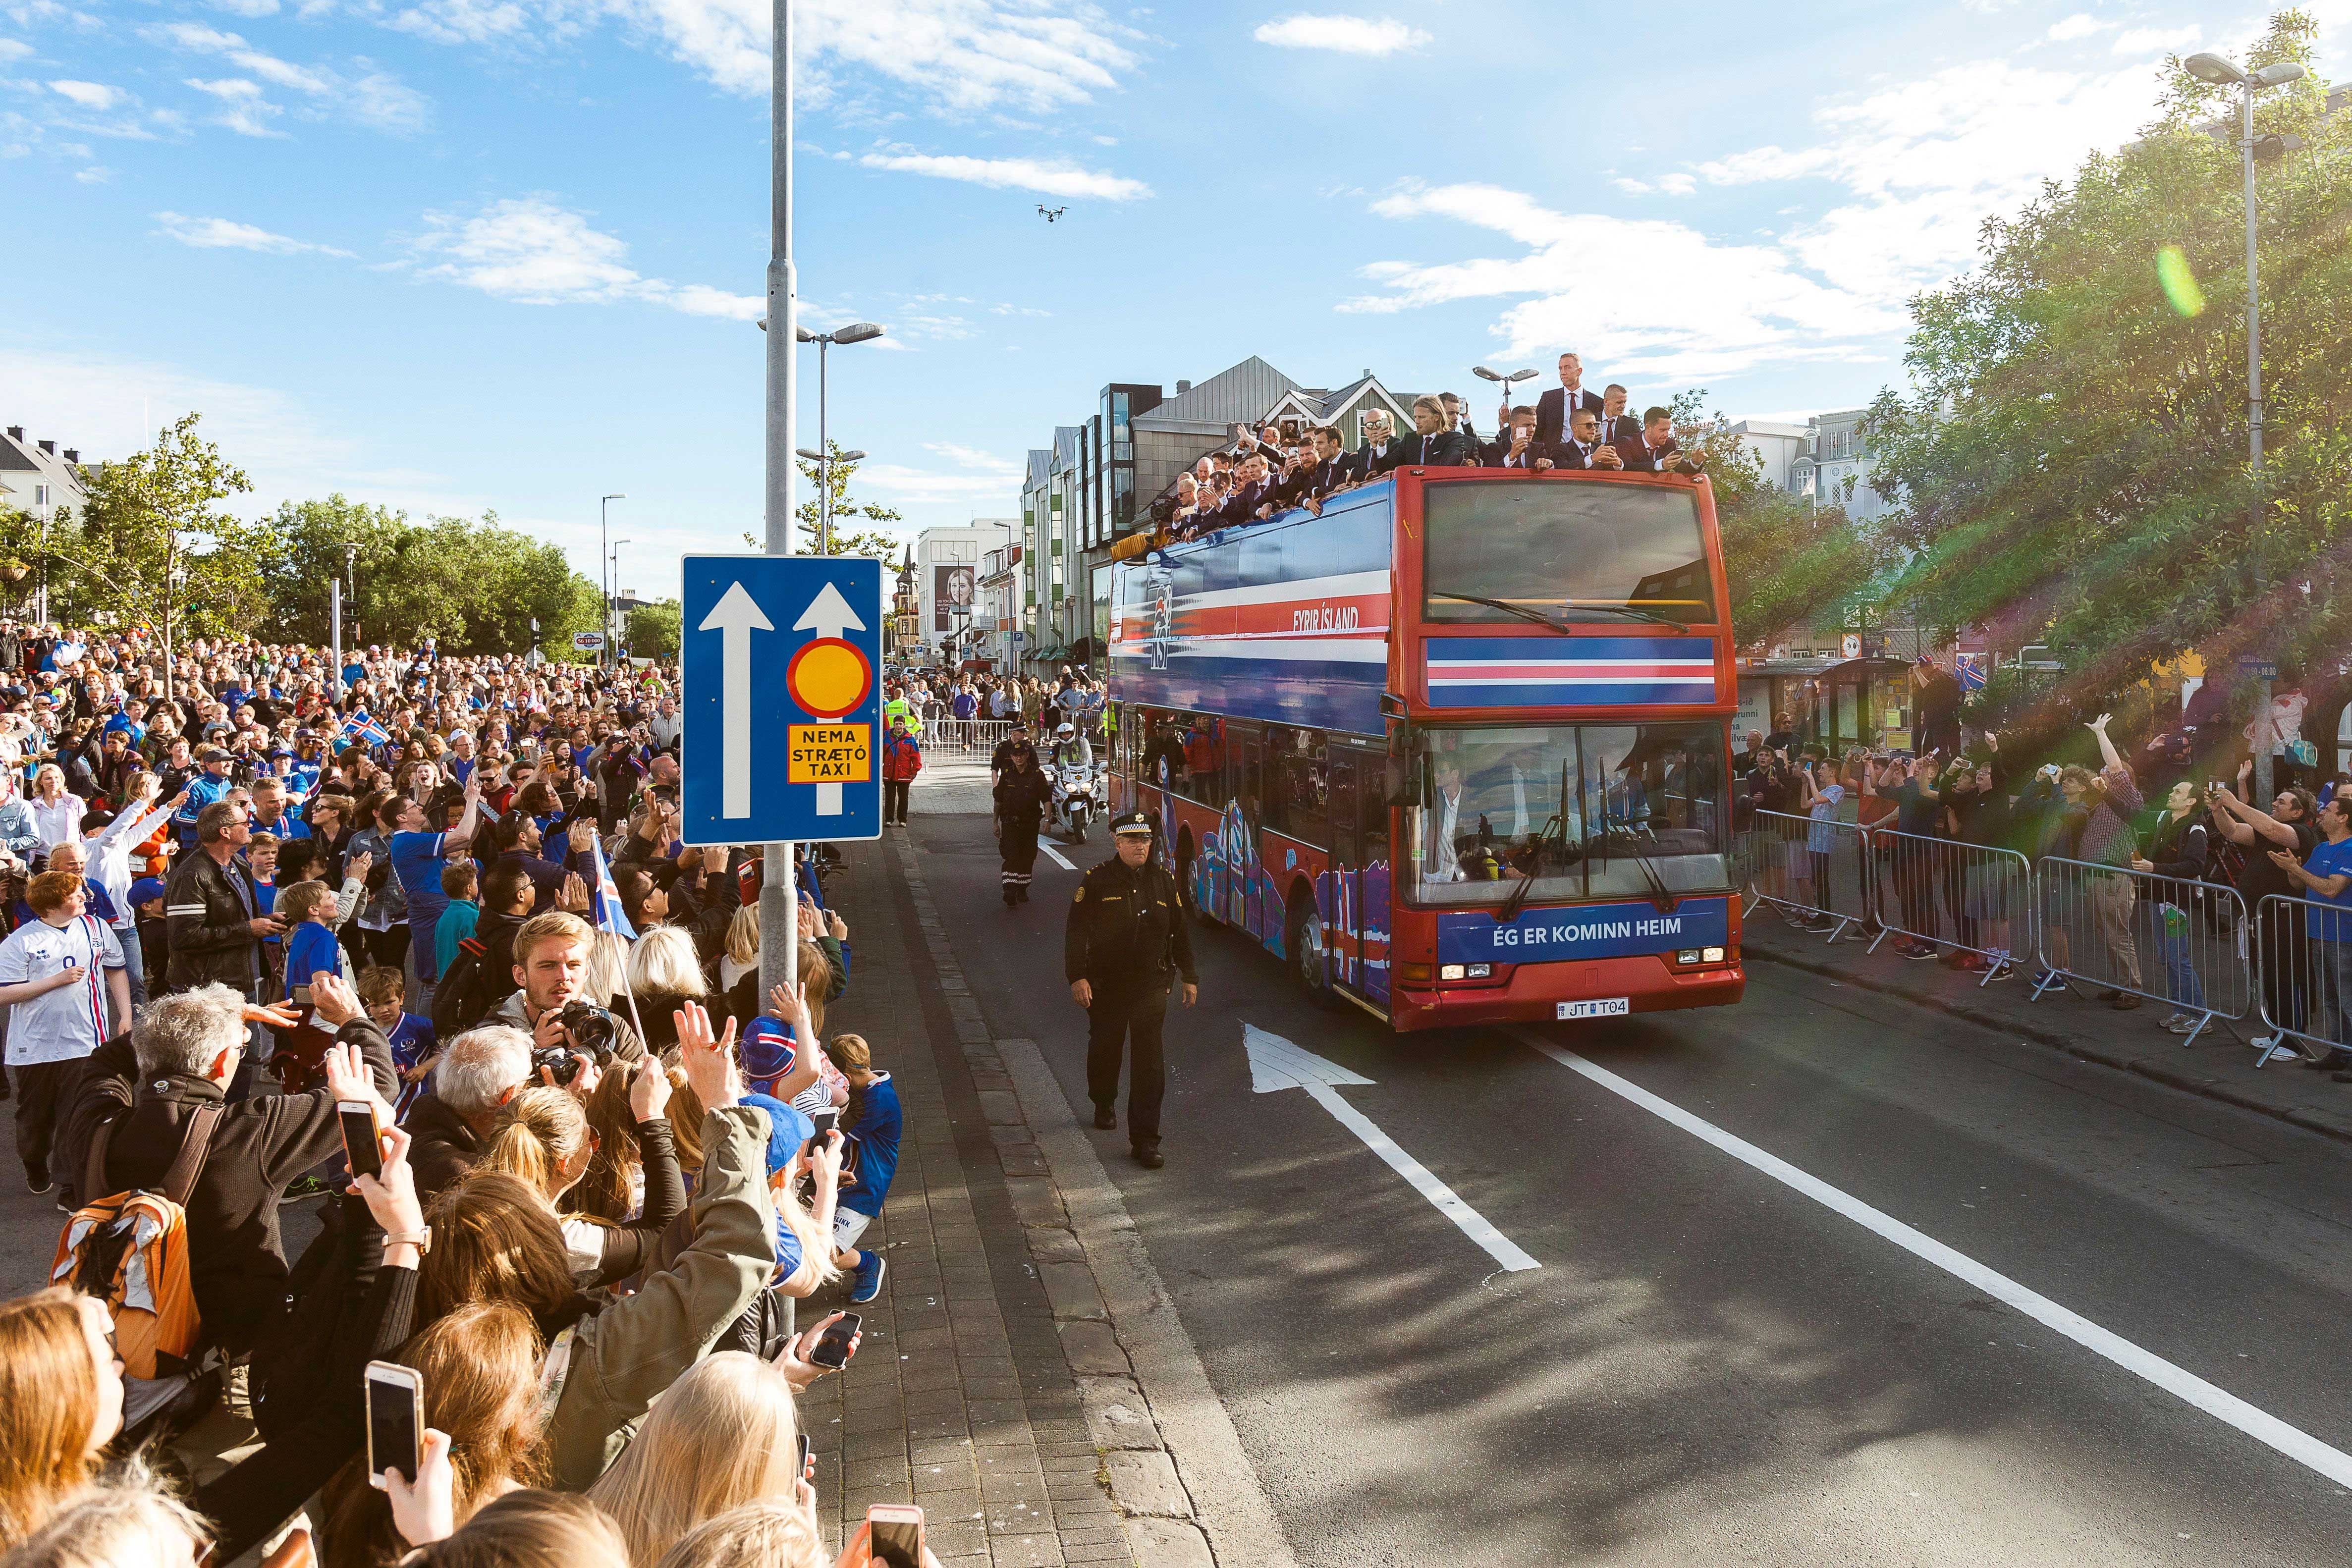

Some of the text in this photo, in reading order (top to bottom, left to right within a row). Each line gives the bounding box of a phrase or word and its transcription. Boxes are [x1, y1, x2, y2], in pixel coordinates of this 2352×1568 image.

[1293, 601, 1359, 632] FYRIR ÍSLAND
[803, 730, 856, 743] NEMA
[792, 745, 866, 761] STRÆTÓ
[809, 763, 850, 776] TAXI
[1493, 918, 1681, 946] ÉG ER KOMINN HEIM
[1570, 1004, 1586, 1016] JT
[1599, 1001, 1626, 1014] T04
